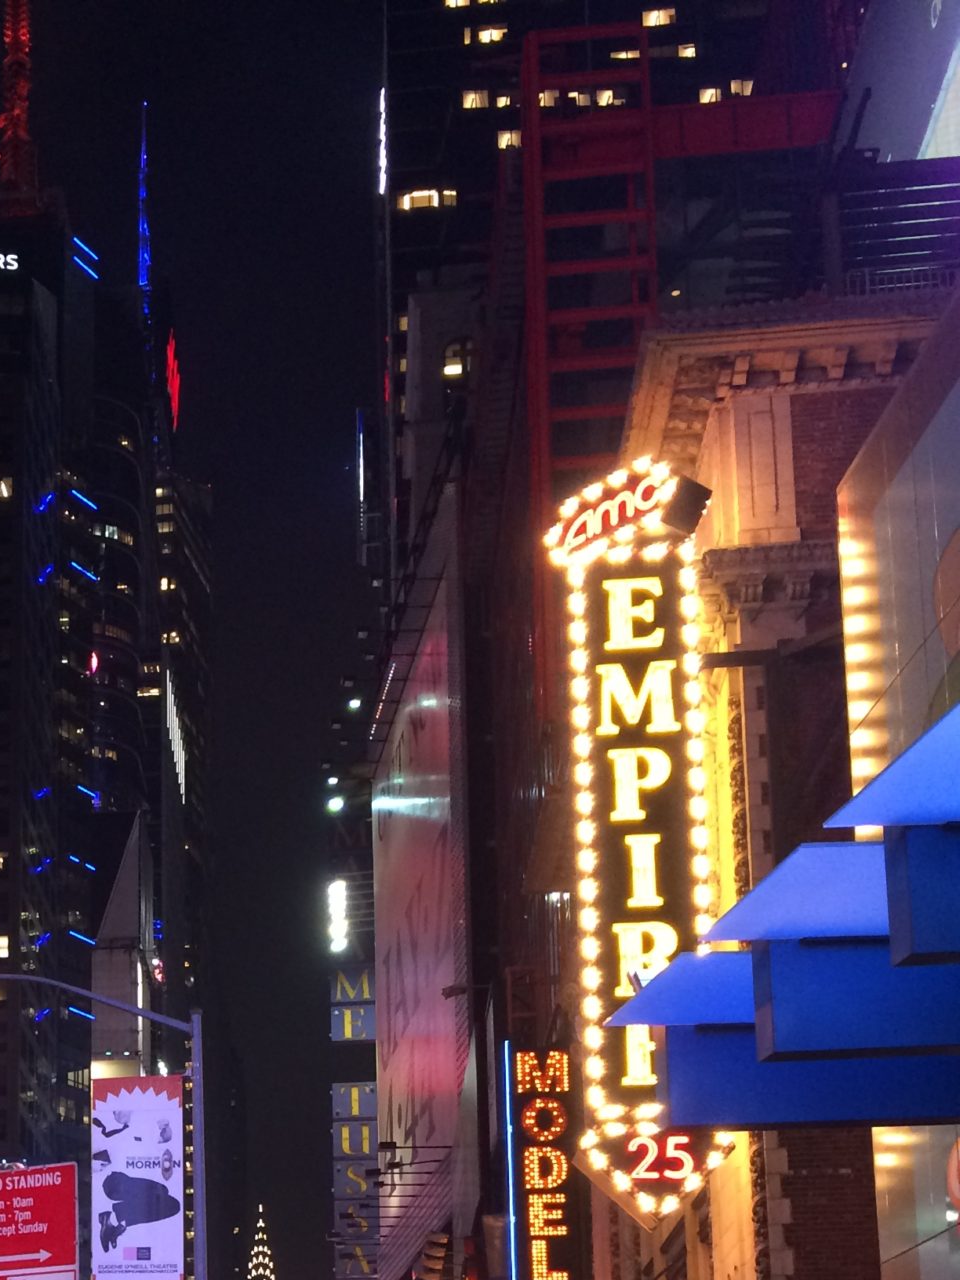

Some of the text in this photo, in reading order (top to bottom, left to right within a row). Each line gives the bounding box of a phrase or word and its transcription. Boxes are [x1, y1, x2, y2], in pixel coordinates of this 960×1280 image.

[627, 1136, 695, 1180] 25
[6, 1172, 62, 1190] STANDING
[12, 1197, 34, 1208] 10am
[14, 1210, 31, 1222] 7pm
[18, 1221, 48, 1234] Sunday
